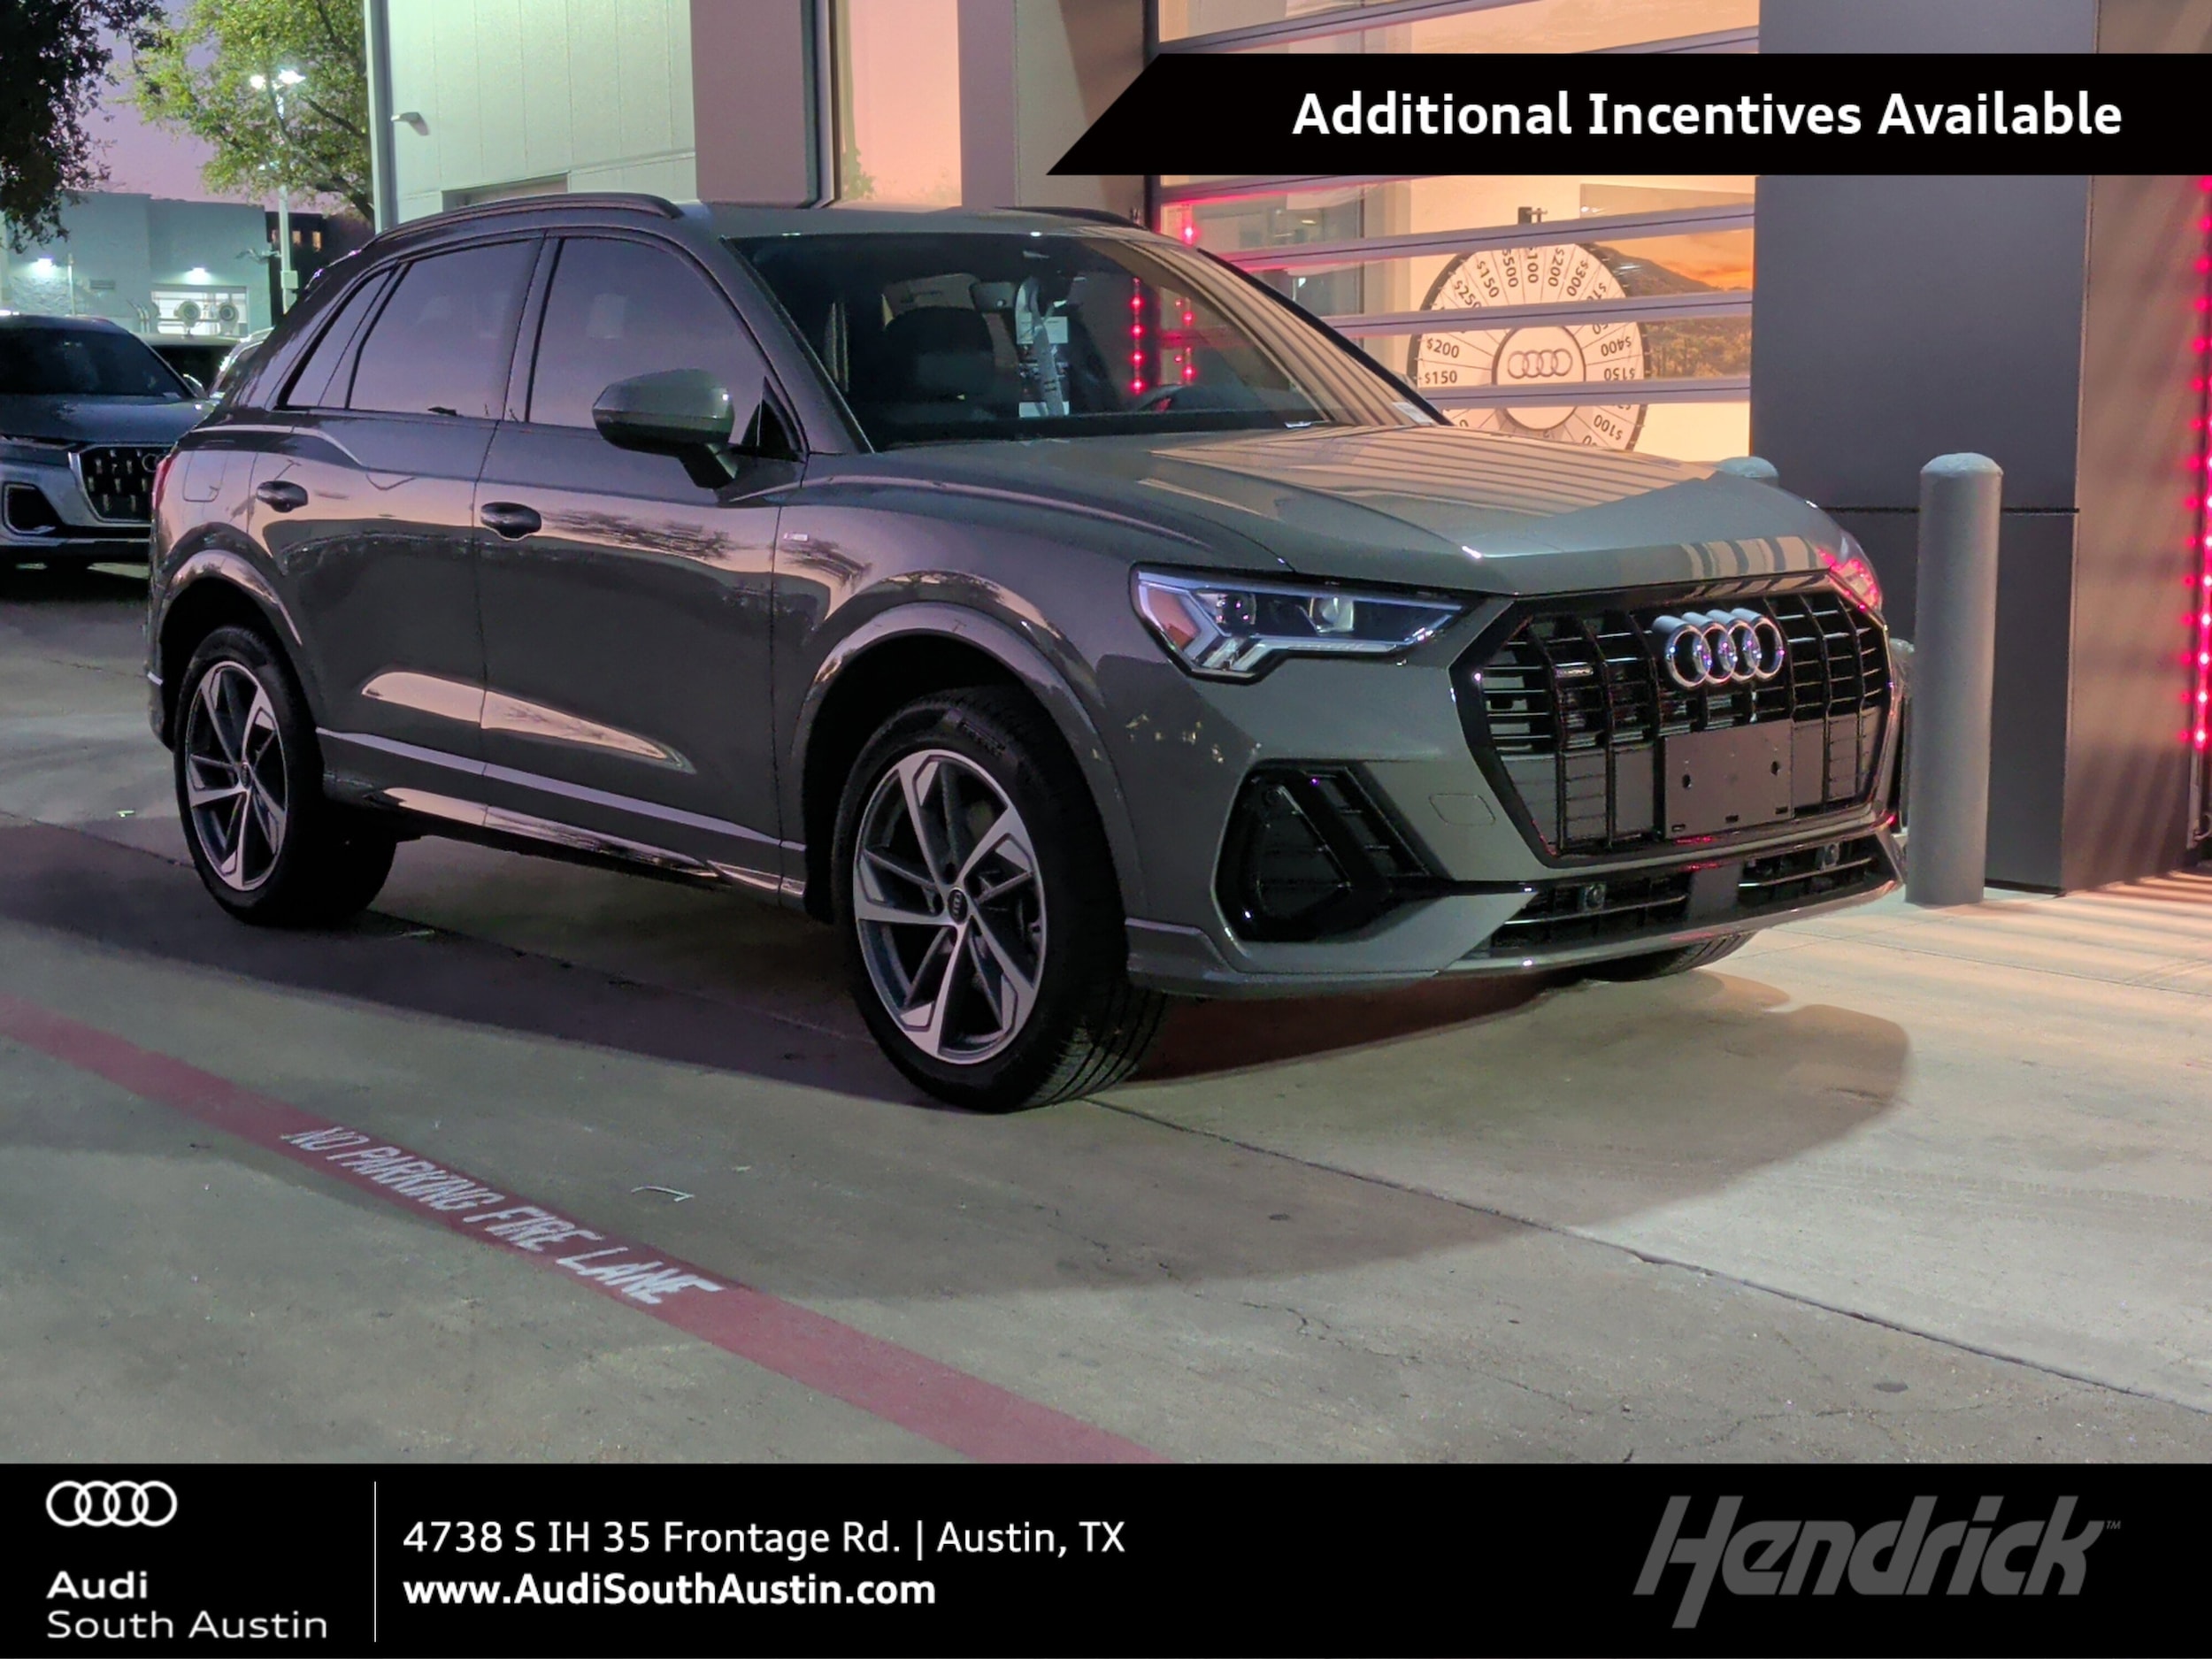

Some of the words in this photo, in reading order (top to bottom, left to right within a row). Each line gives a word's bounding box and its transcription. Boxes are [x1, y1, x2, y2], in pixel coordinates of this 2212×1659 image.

[1477, 260, 1500, 298] $150
[1548, 247, 1565, 288] $200
[1566, 259, 1589, 297] $300
[1426, 337, 1460, 359] $200
[1601, 335, 1632, 357] $400
[1425, 370, 1458, 385] $150
[1603, 367, 1636, 381] $150
[1593, 414, 1624, 441] $100
[280, 1126, 370, 1151] NO
[326, 1146, 505, 1211] PARKING
[463, 1205, 605, 1252] FIRE
[556, 1247, 725, 1304] LANE
